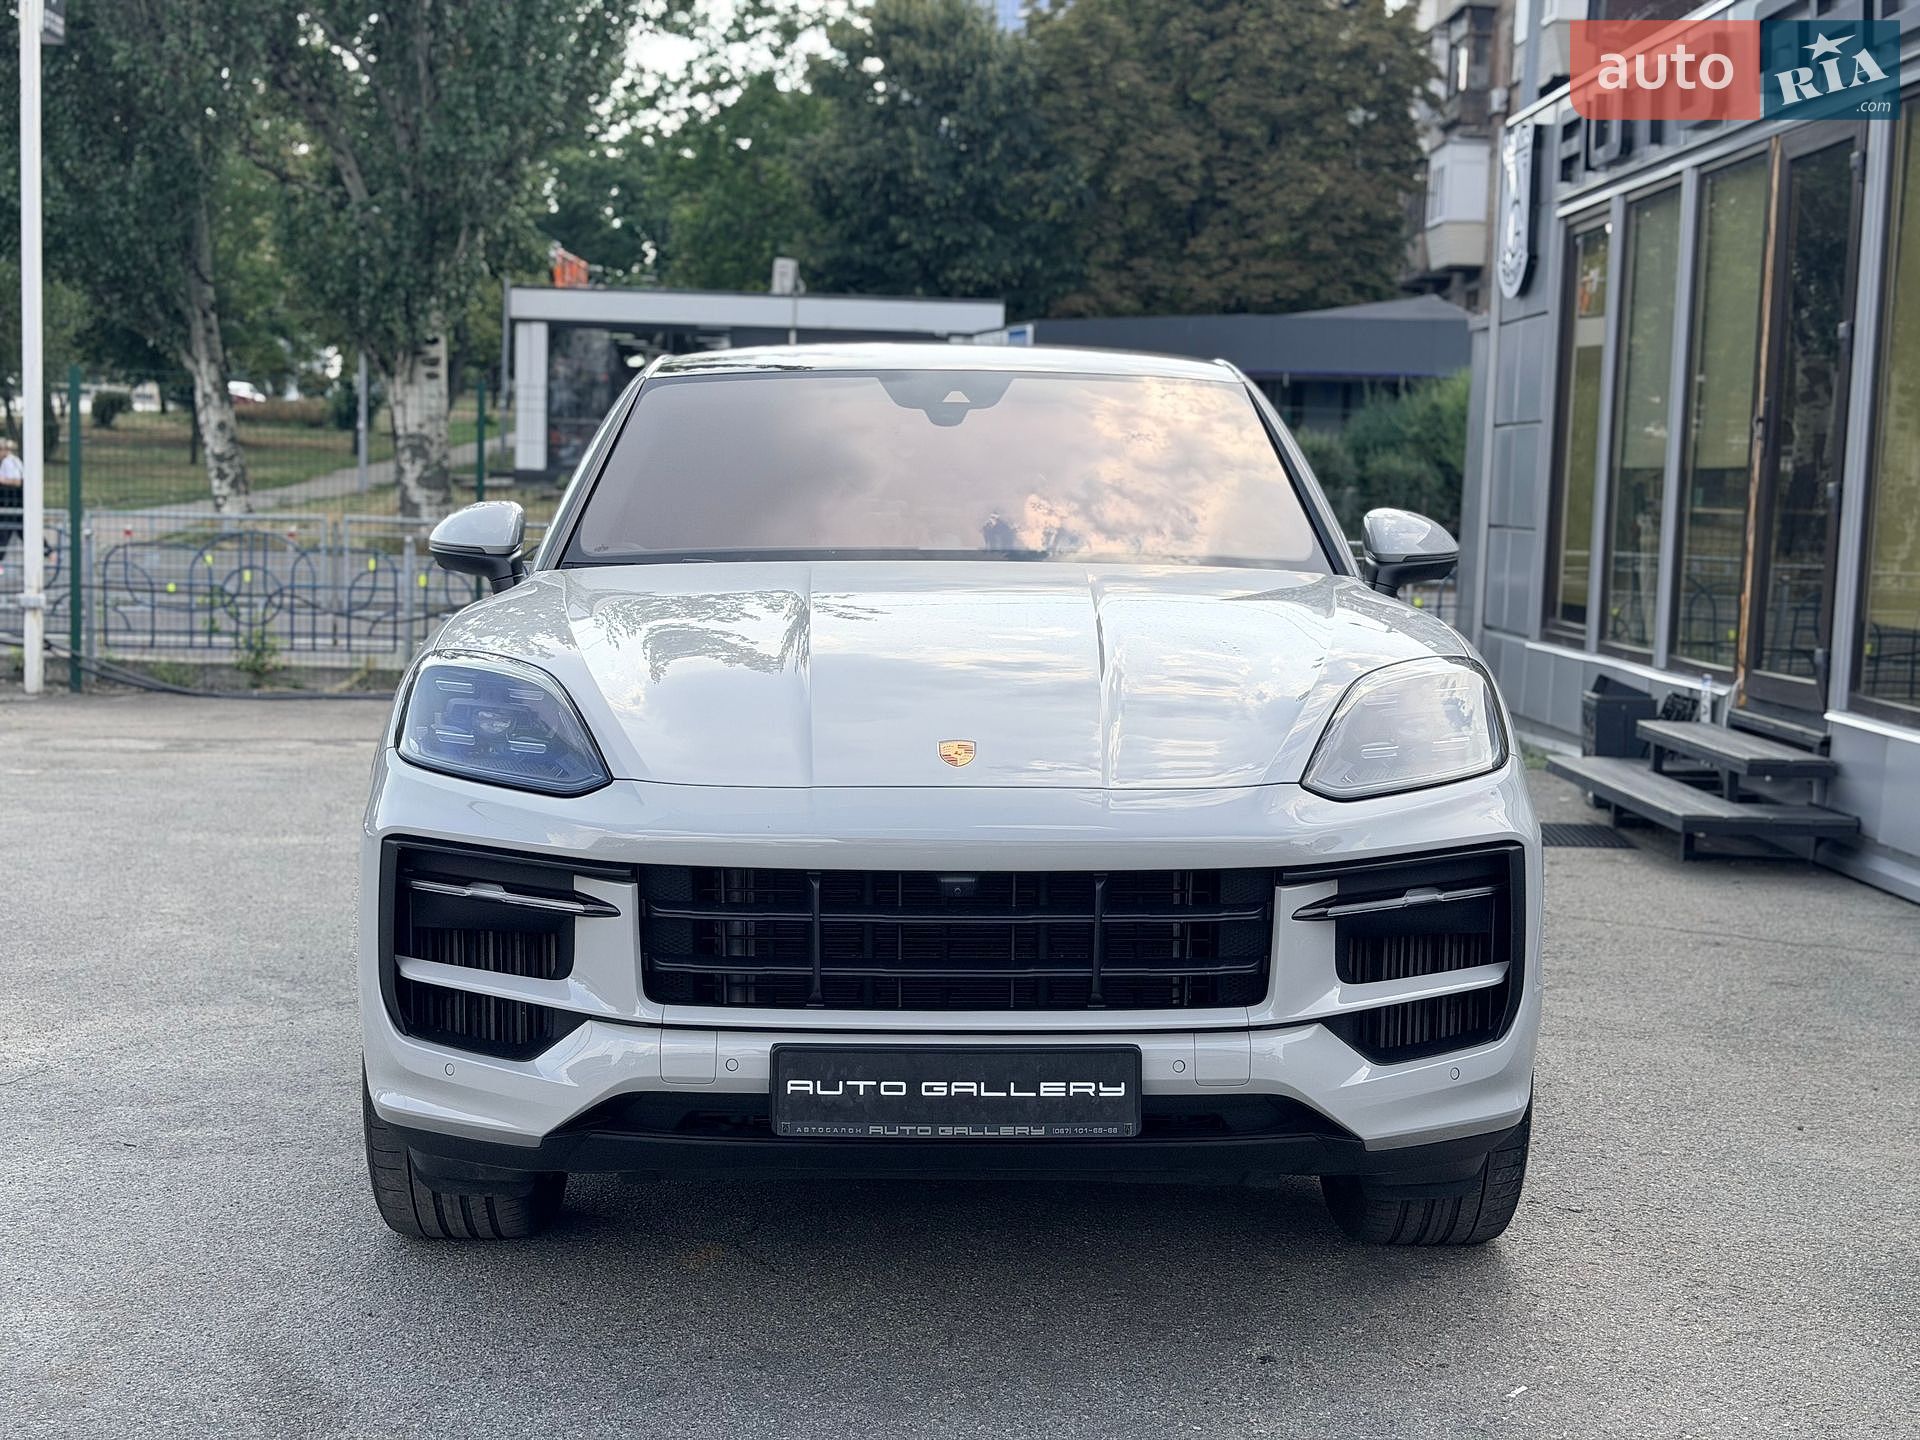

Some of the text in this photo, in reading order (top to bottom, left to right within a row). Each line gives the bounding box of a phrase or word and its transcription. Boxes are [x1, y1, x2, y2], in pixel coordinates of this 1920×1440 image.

[786, 1079, 1126, 1097] AUTO GALLERY
[868, 1125, 932, 1136] AUTO
[938, 1125, 1046, 1136] GALLERY
